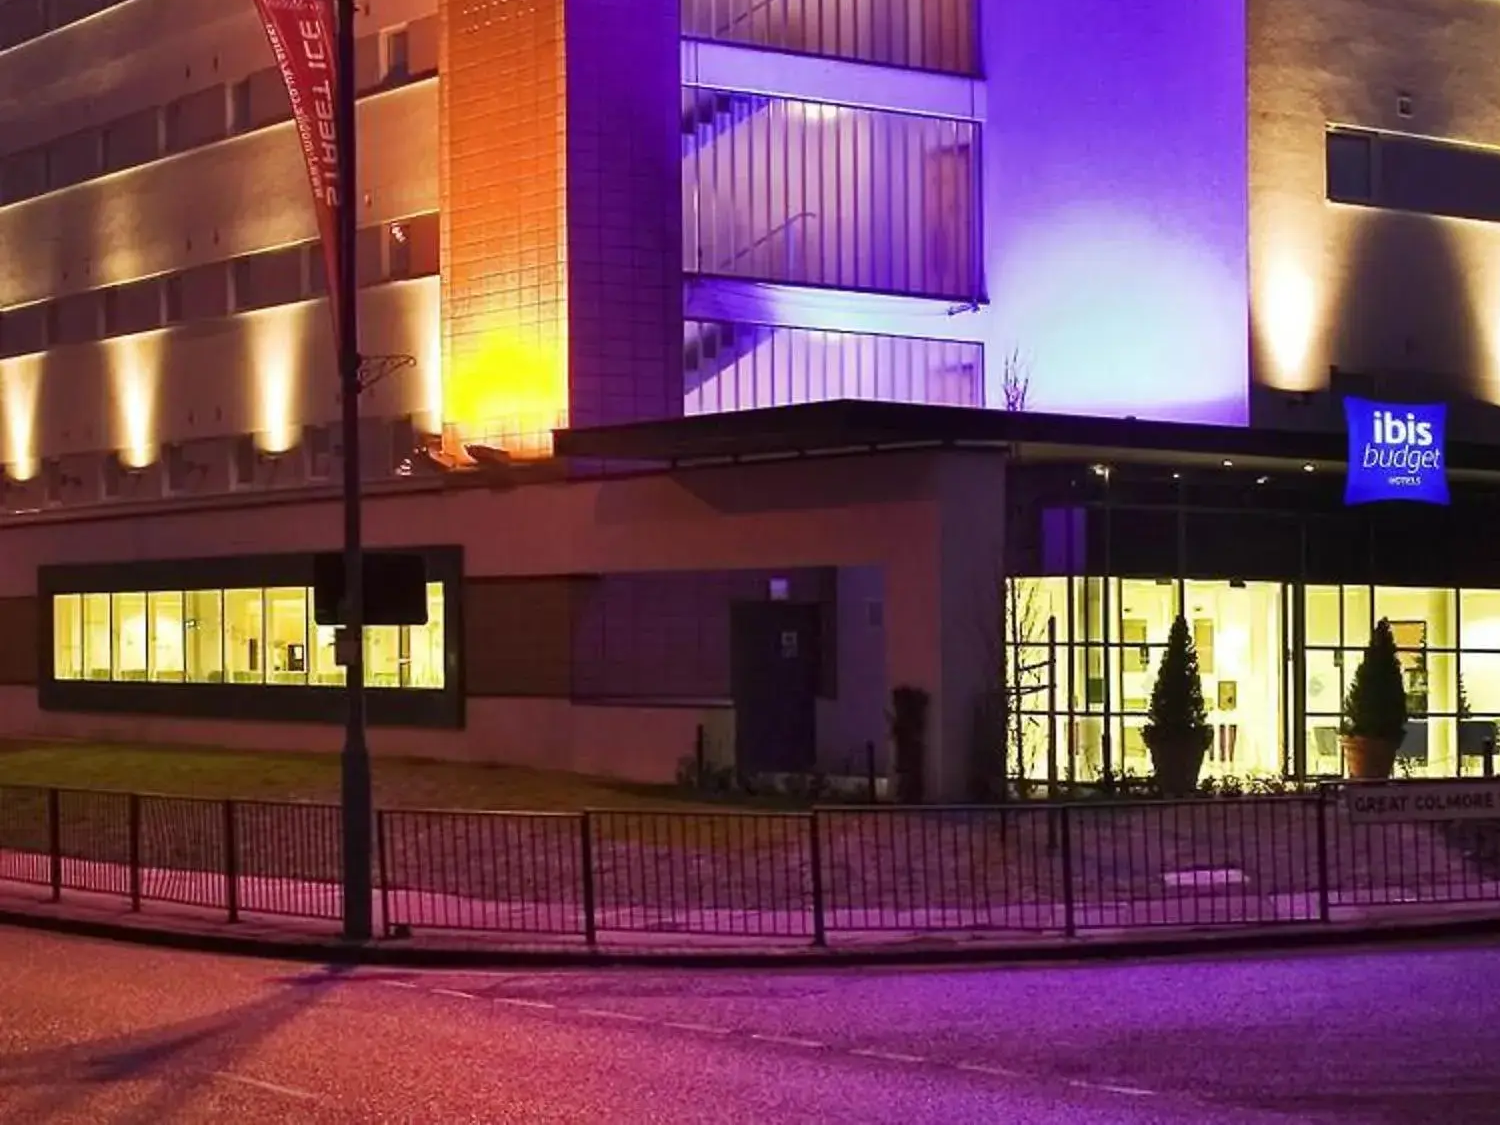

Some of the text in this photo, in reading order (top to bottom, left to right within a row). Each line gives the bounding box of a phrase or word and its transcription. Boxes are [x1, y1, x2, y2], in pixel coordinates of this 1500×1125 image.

[1373, 411, 1433, 446] ibis
[1363, 442, 1441, 474] budget
[1354, 795, 1408, 814] GREAT
[1415, 791, 1495, 811] COLMORE
